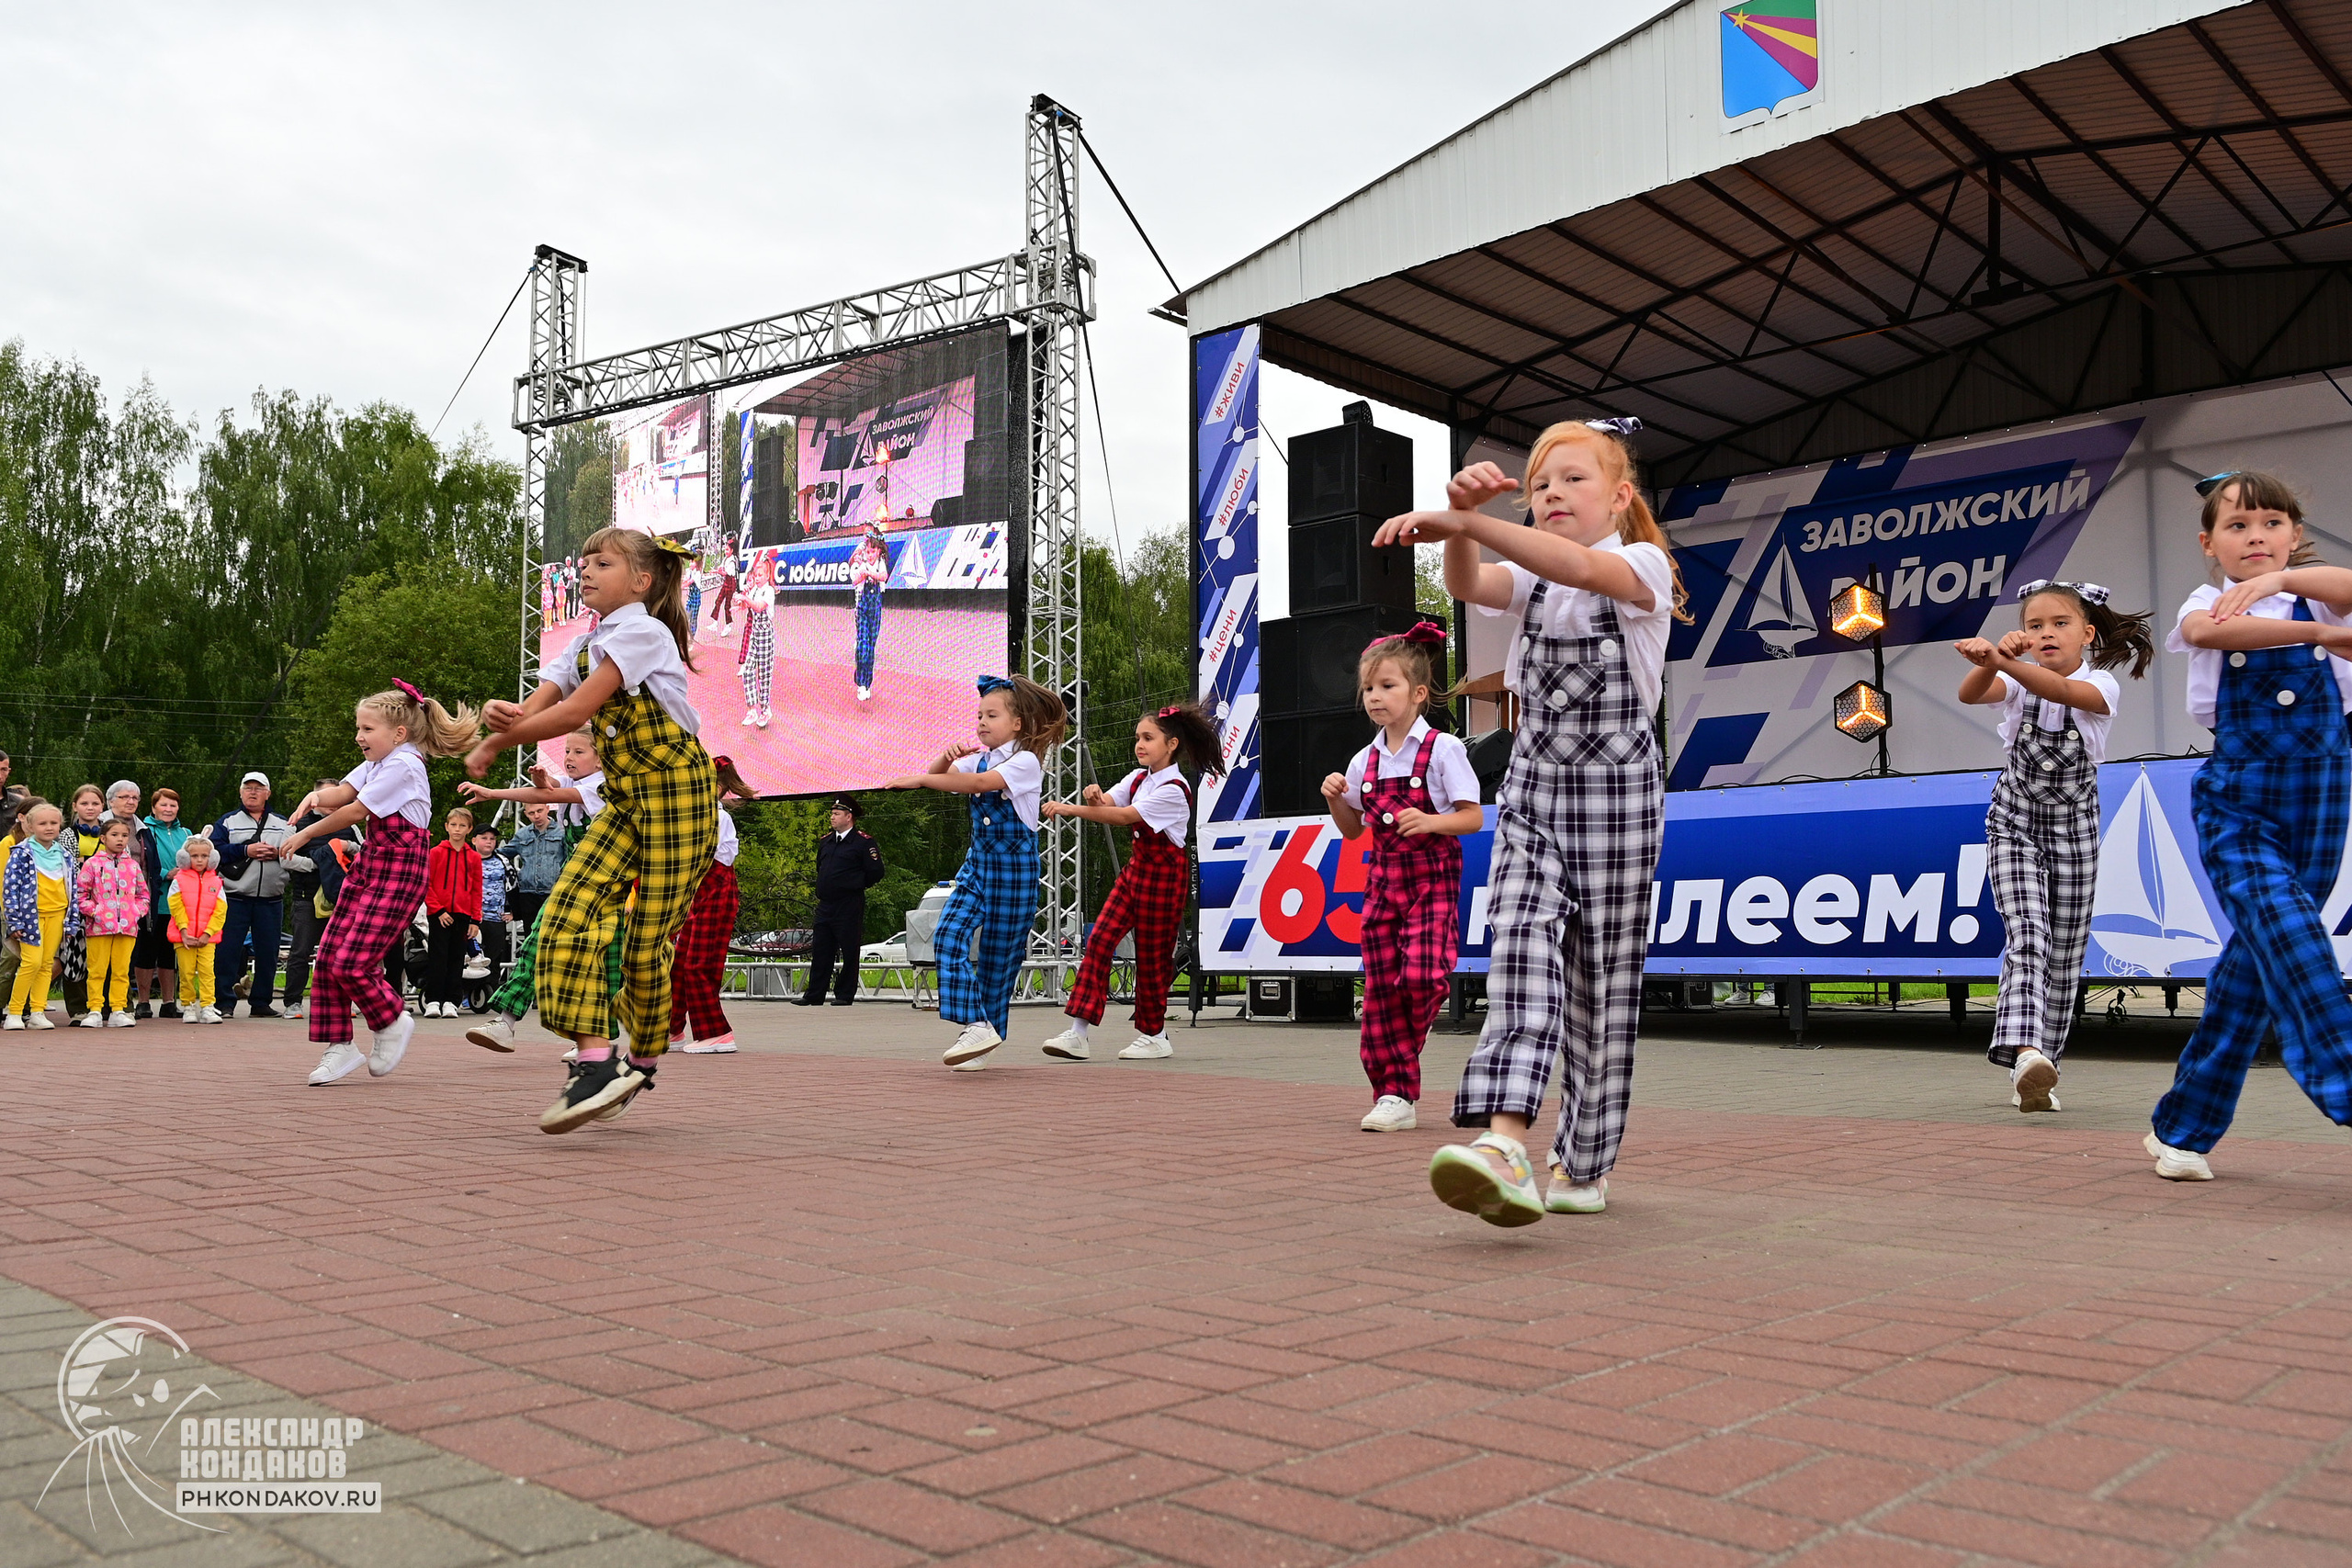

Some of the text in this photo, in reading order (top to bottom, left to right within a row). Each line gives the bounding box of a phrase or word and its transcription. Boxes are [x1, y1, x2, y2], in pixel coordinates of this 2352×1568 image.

[1216, 362, 1245, 418] #живи
[872, 405, 934, 435] ЗАВОЛЖСКИЙ
[1218, 468, 1249, 526] #люби
[1800, 468, 2091, 553] ЗАВОЛЖСКИЙ
[775, 559, 787, 584] С
[789, 558, 864, 583] юбилее
[1208, 609, 1238, 663] #цени
[1206, 726, 1240, 790] #ани
[1466, 843, 1987, 945] леем!
